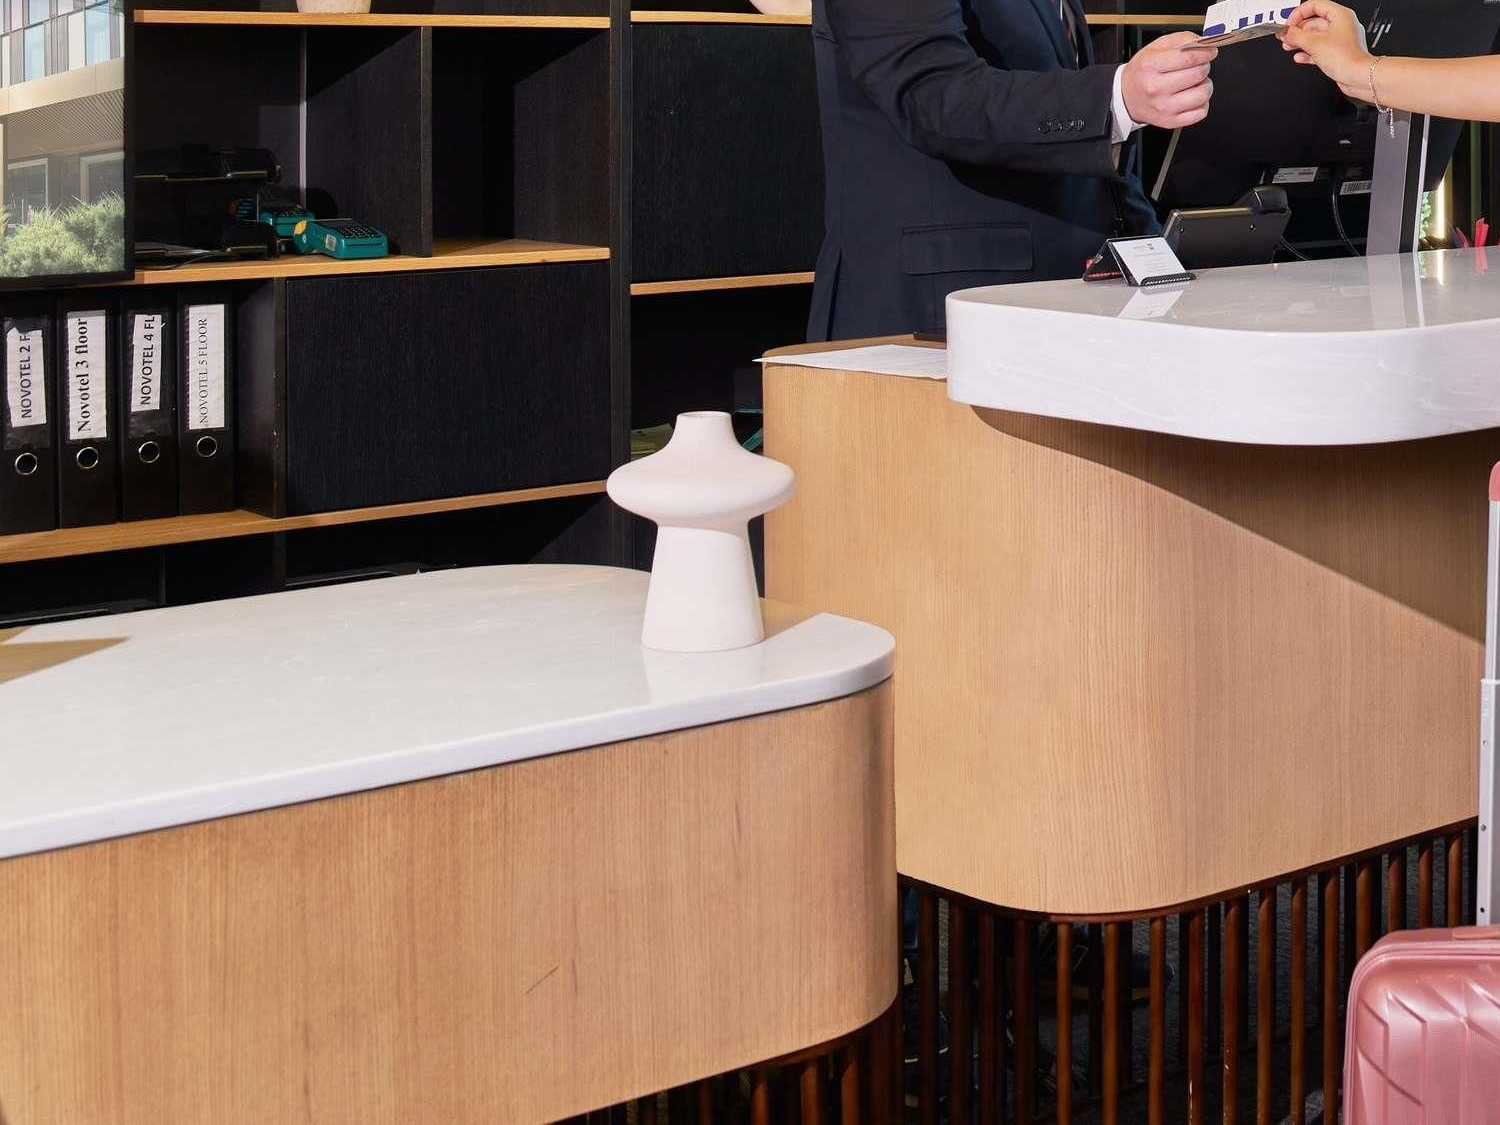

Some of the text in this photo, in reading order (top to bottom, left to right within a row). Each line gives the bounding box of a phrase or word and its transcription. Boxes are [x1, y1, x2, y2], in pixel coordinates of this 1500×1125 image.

[20, 345, 31, 353] 2
[140, 315, 155, 405] NOVOTEL 4 FL
[198, 318, 208, 357] FLOOR
[19, 356, 32, 418] NOVOTEL
[75, 318, 91, 432] Novotel 3 floor
[199, 369, 209, 425] NOVOTEL
